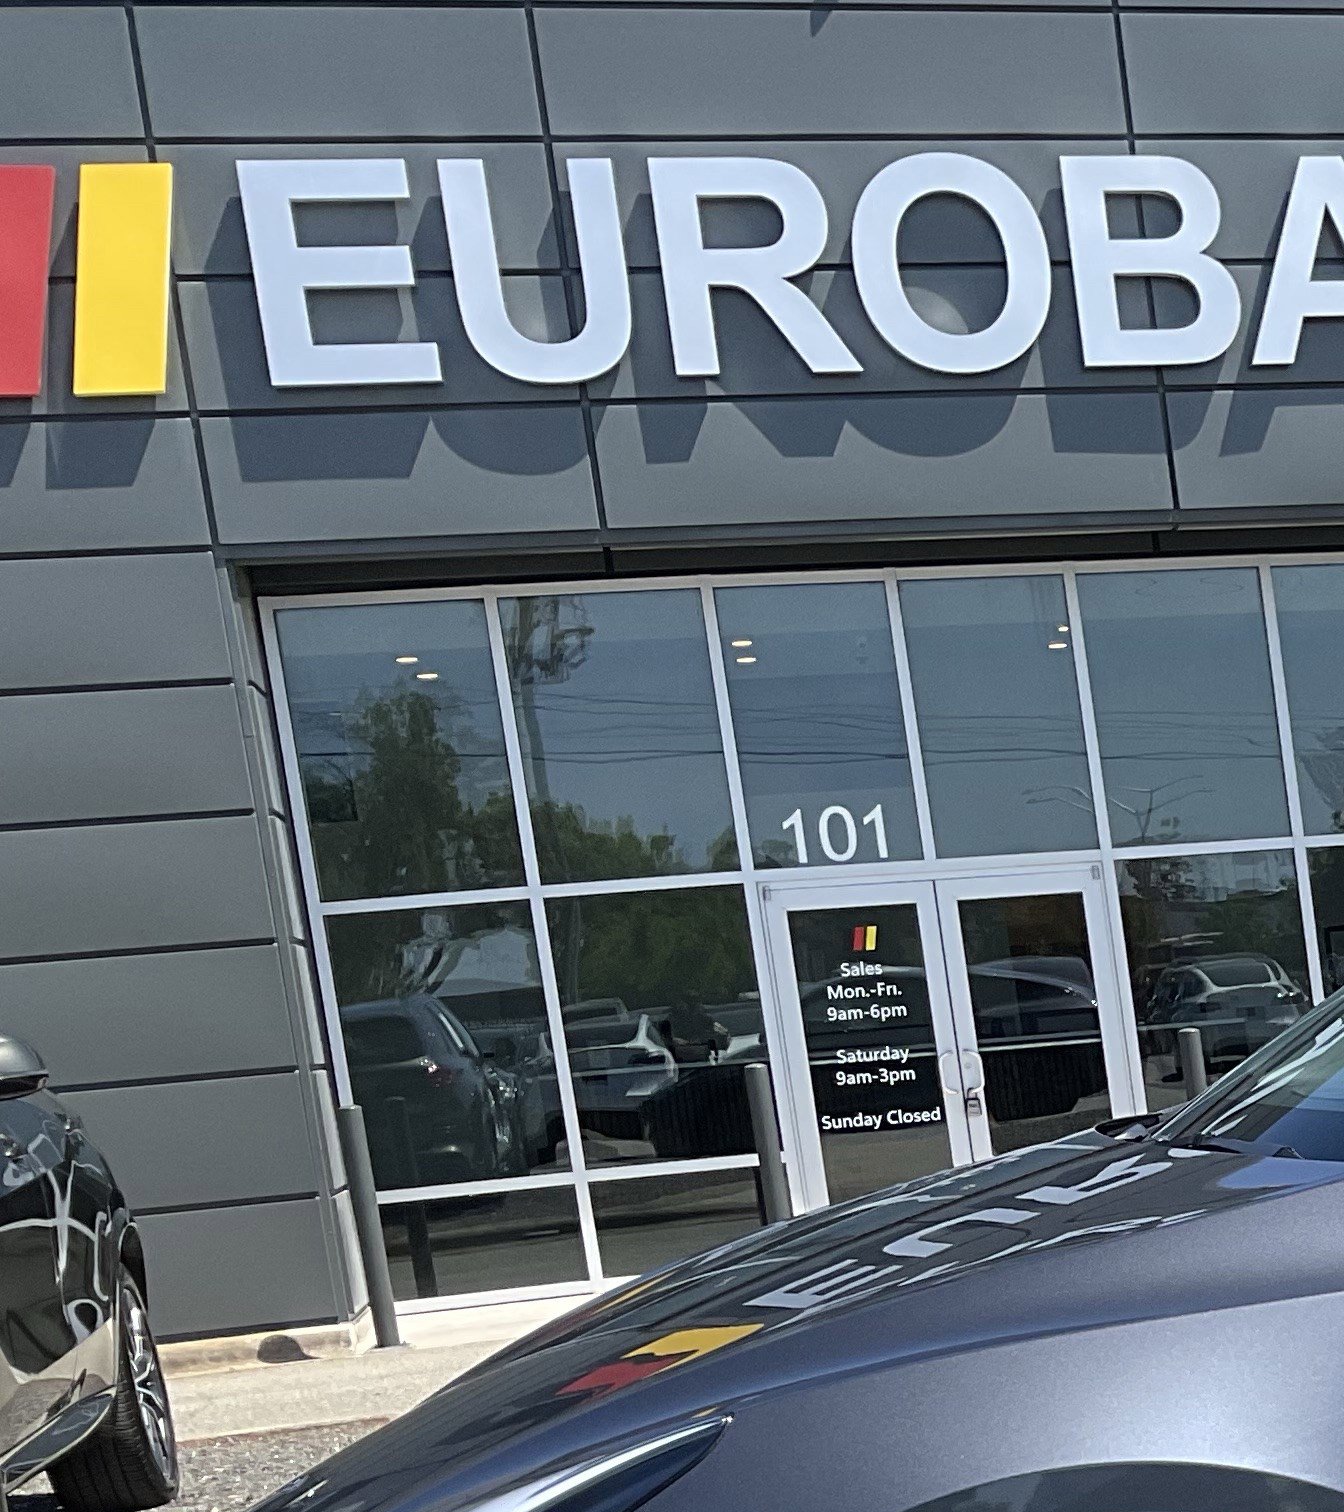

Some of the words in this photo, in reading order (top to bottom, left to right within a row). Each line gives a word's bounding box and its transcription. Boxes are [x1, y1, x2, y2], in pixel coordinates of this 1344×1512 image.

[781, 803, 890, 865] 101
[840, 961, 884, 978] Sales
[826, 981, 903, 1000] Mon.-Fri.
[826, 1003, 908, 1022] 9am-6pm
[836, 1045, 910, 1064] Saturday
[835, 1068, 917, 1086] 9am-3pm
[821, 1112, 883, 1130] Sunday
[886, 1106, 942, 1125] Closed
